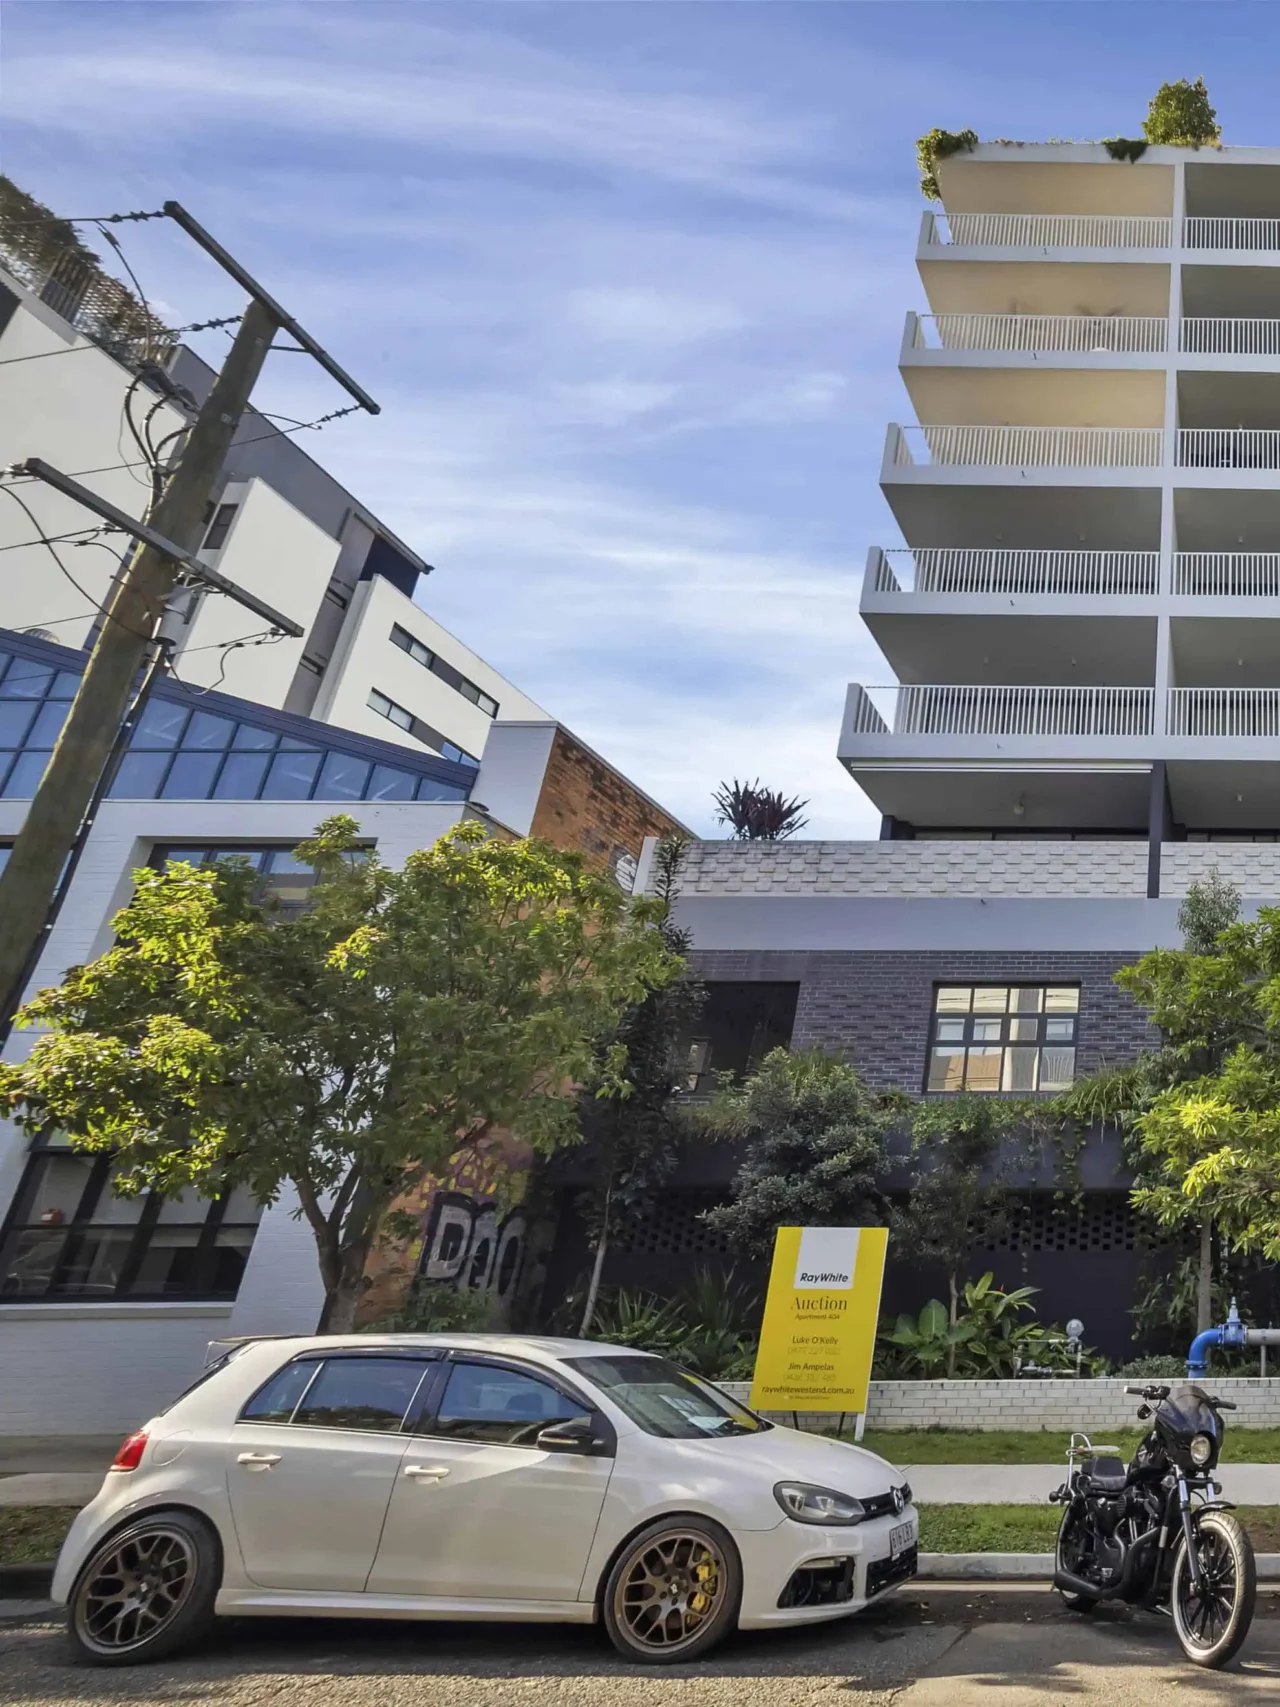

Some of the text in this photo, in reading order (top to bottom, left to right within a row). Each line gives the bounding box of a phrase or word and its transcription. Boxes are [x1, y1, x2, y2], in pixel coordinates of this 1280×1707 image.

[790, 1296, 848, 1311] Auction
[795, 1313, 827, 1321] Apartment
[792, 1335, 839, 1346] Luke O'Kelly
[788, 1362, 835, 1373] Jim Ampelas
[762, 1386, 855, 1396] raywhitewestend.com.au
